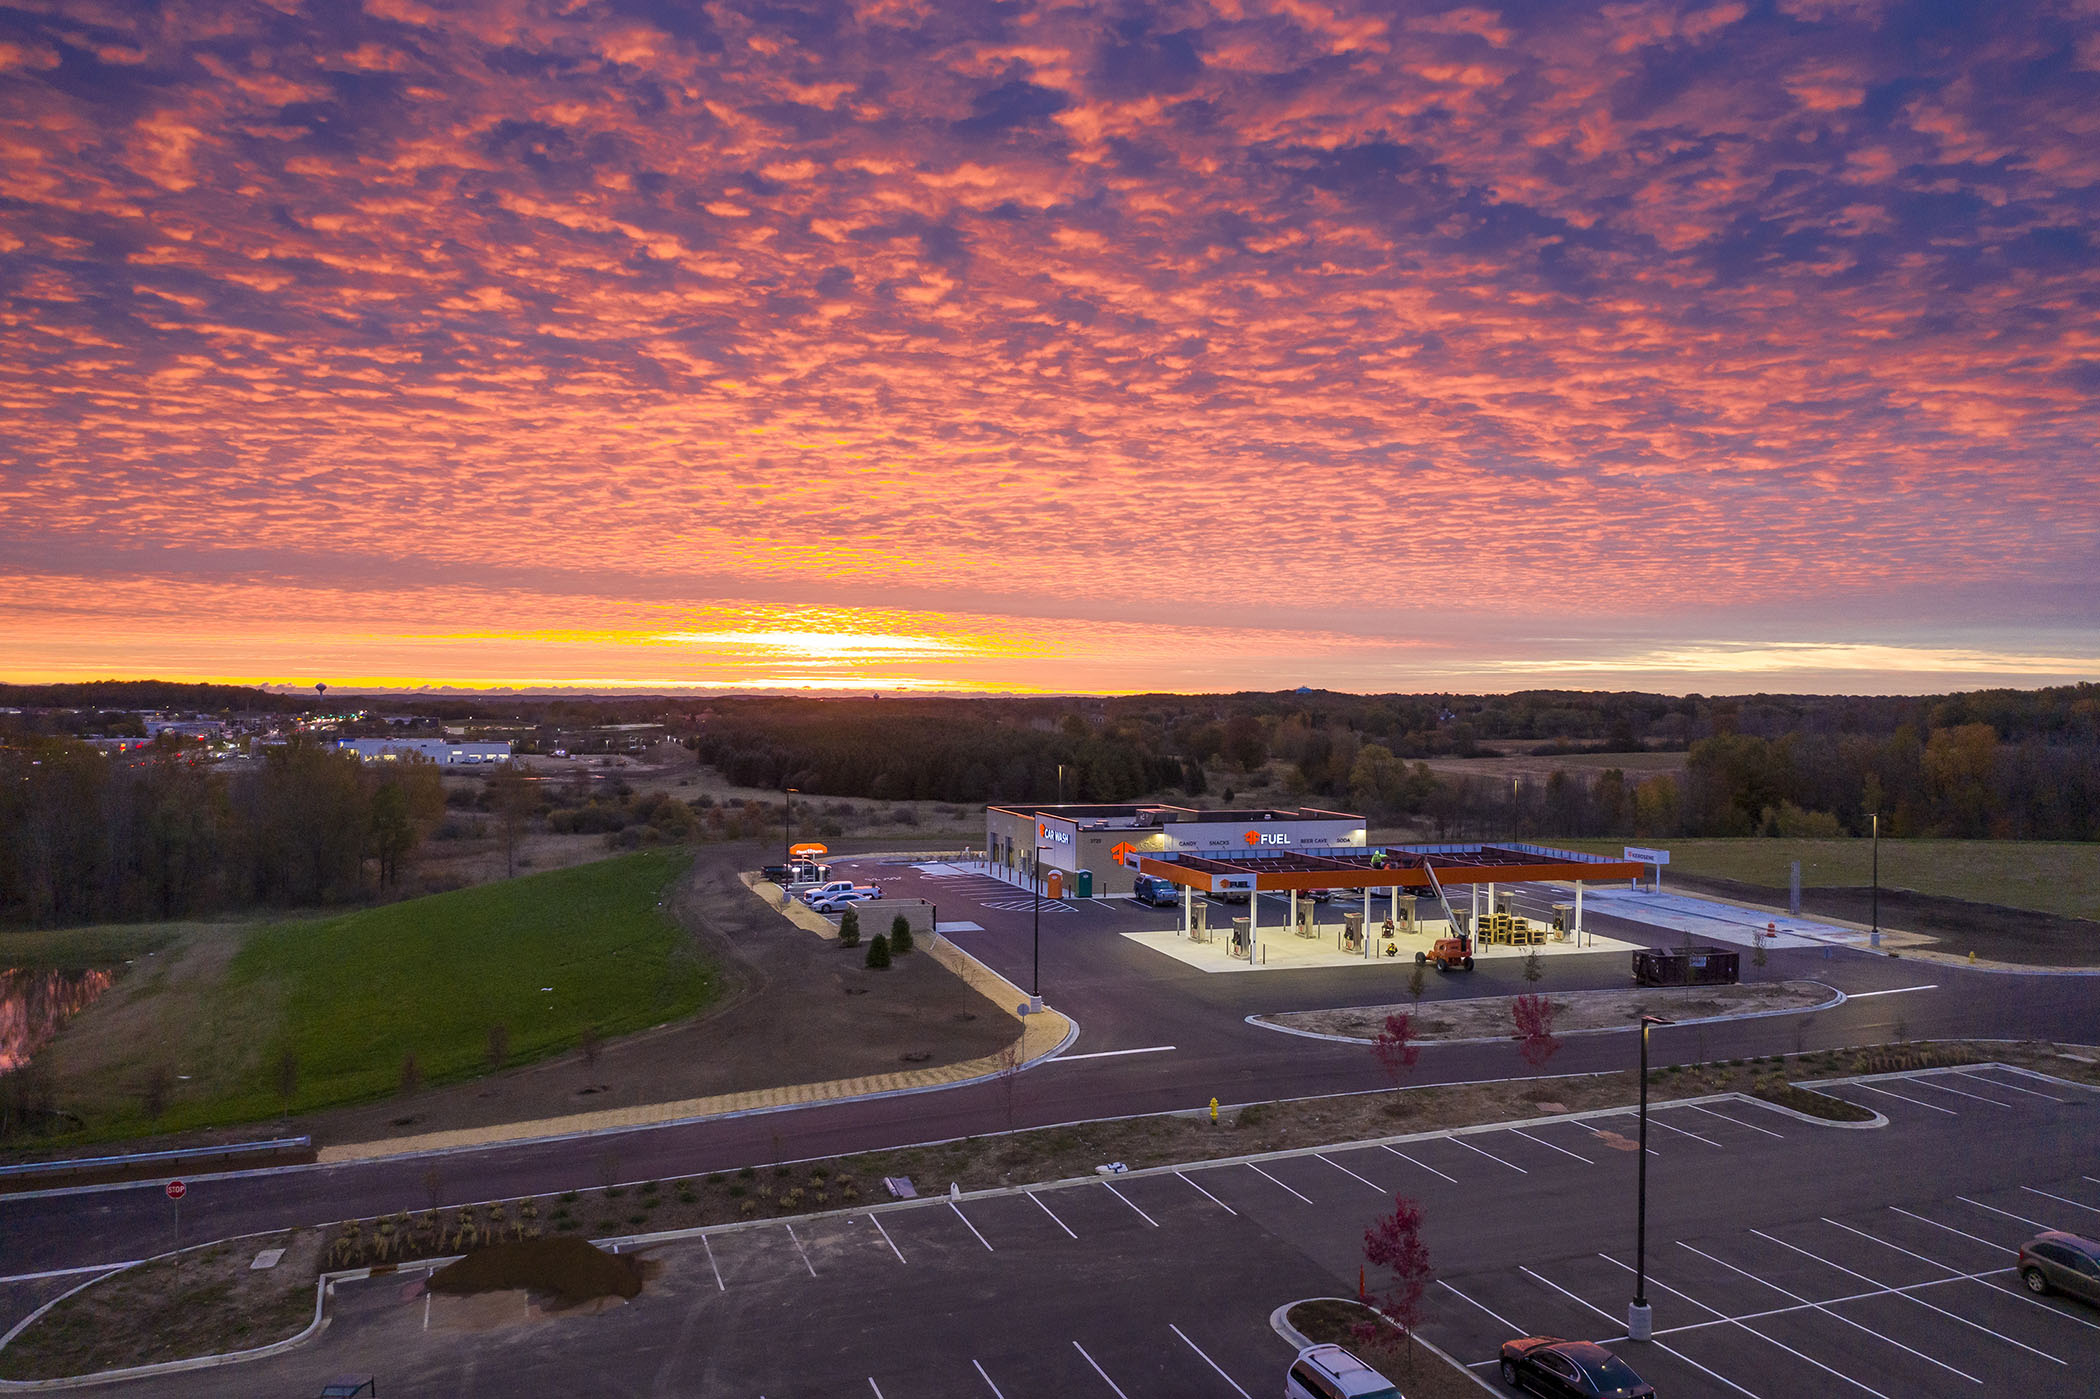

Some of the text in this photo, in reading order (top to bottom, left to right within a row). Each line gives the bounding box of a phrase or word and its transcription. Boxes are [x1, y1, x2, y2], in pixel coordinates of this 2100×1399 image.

[1044, 828, 1069, 845] CAR WASH
[1260, 833, 1291, 845] FUEL
